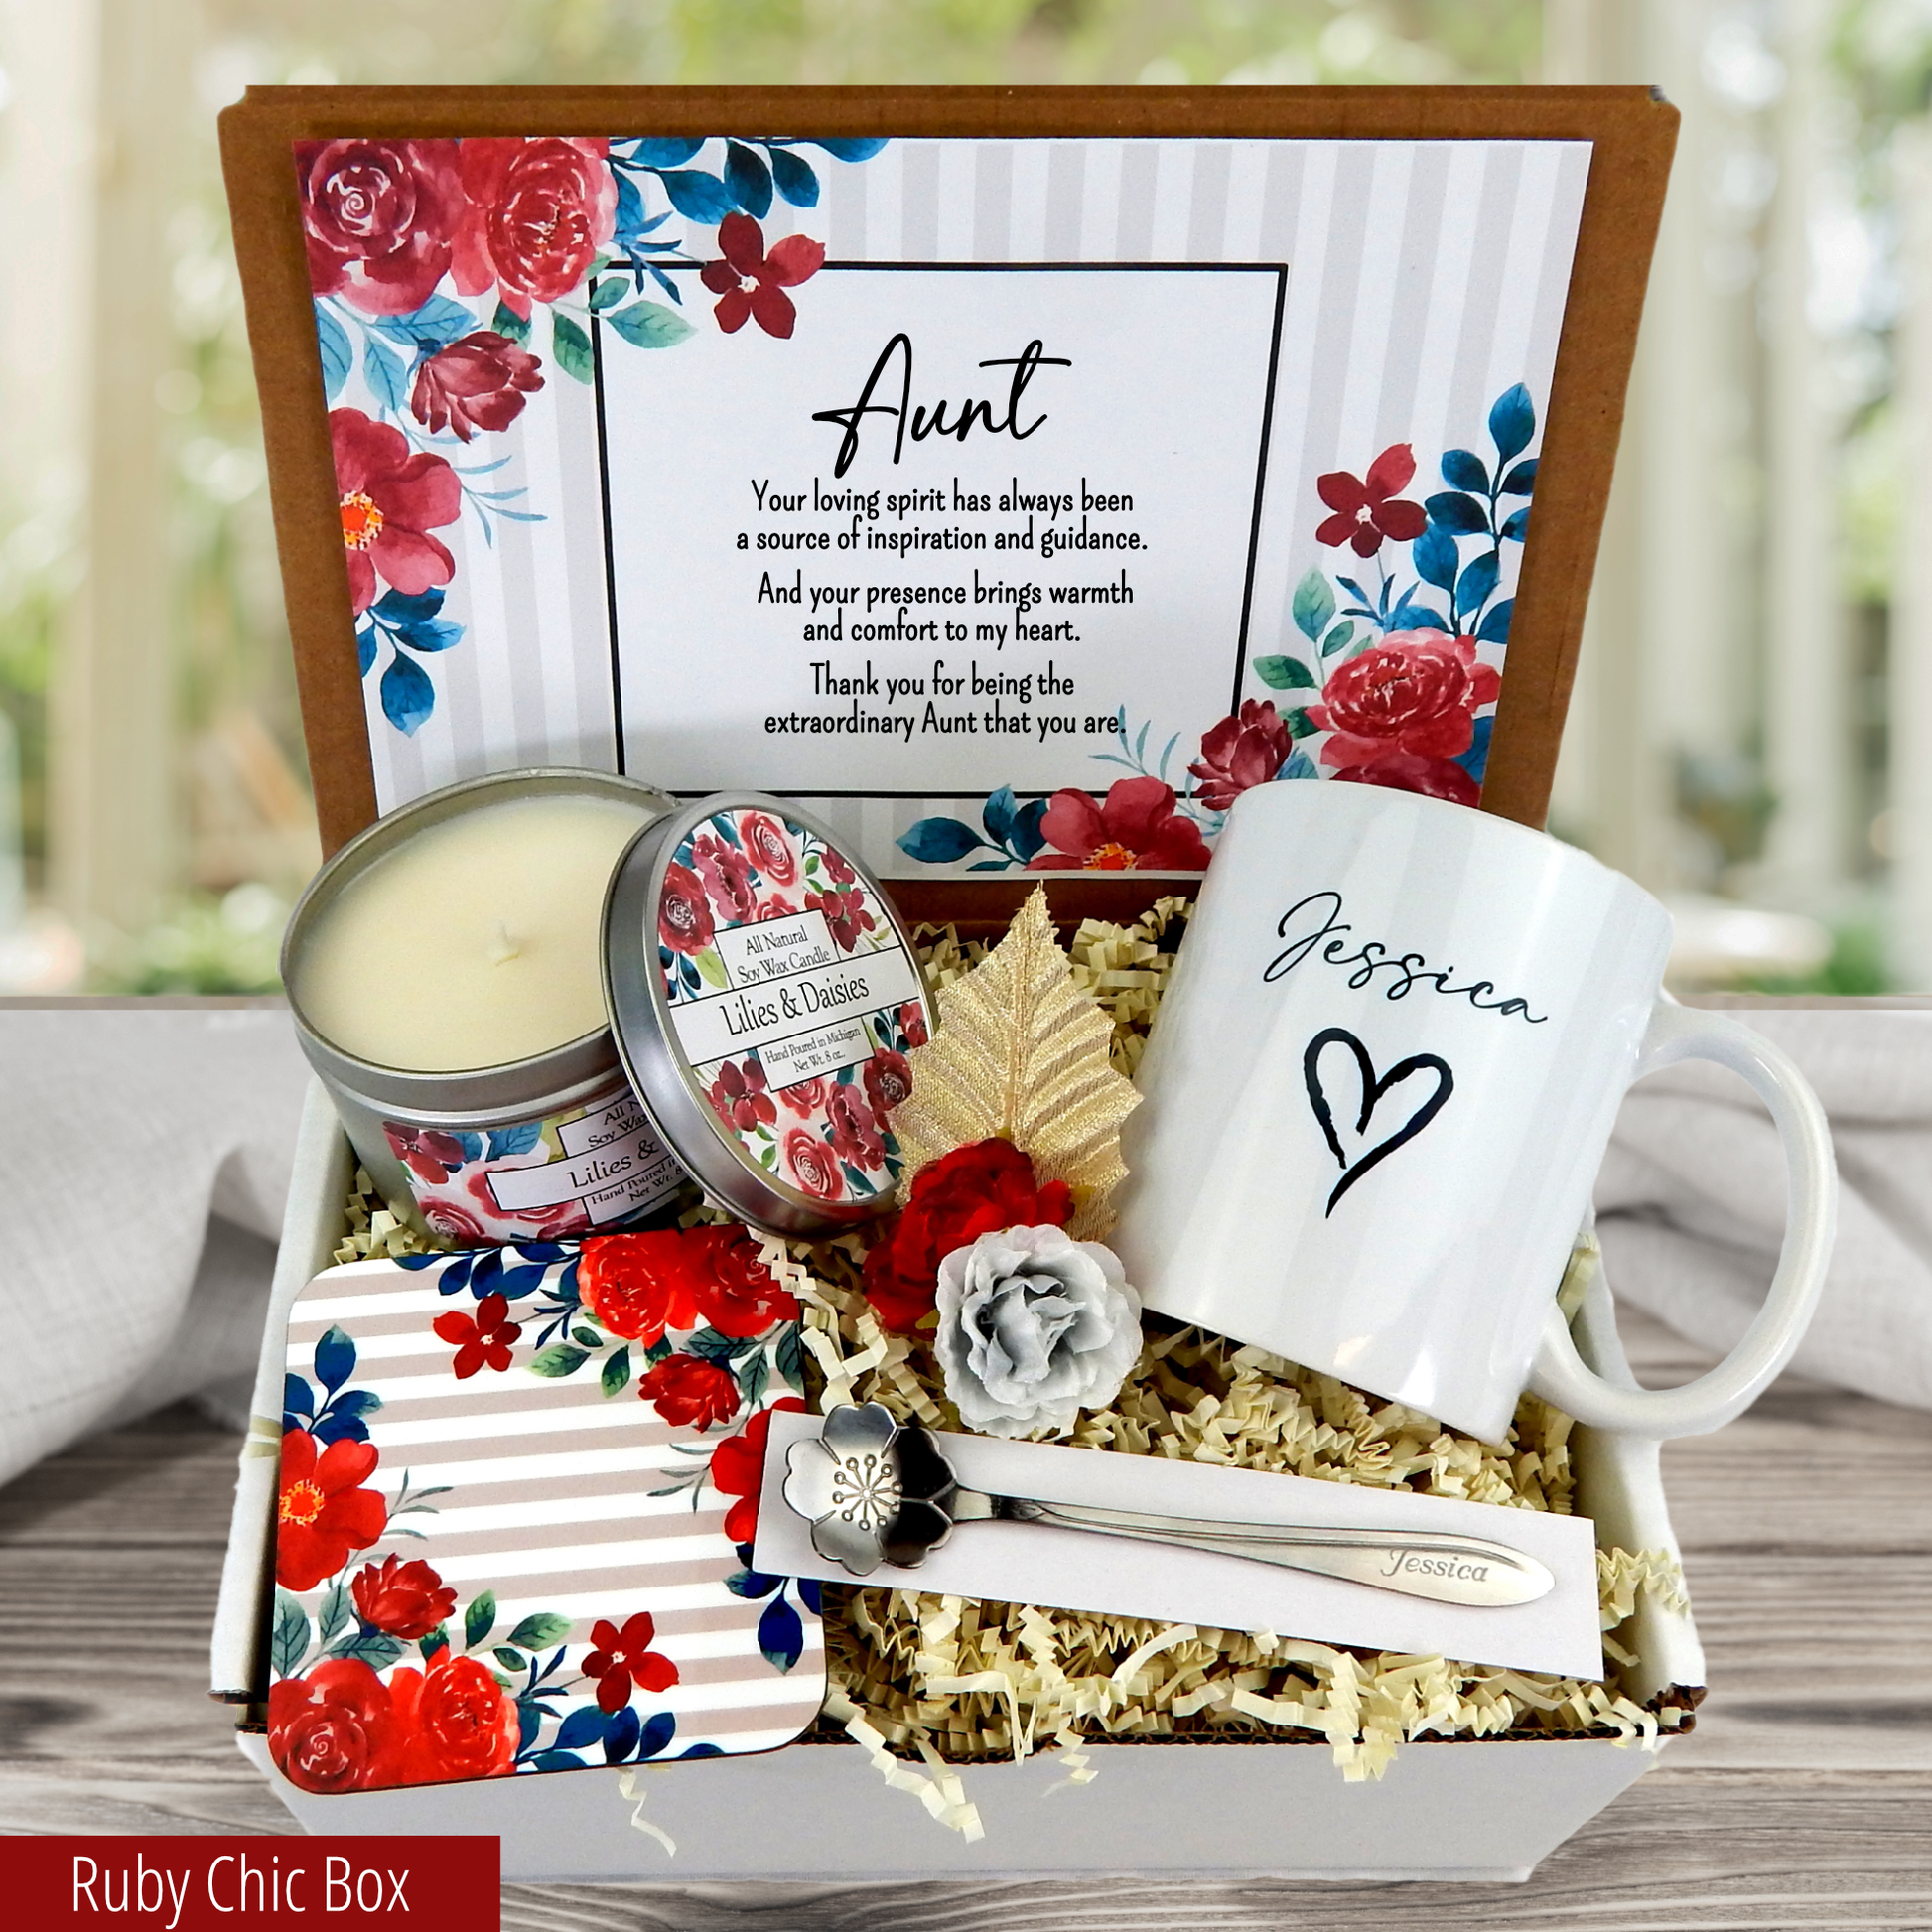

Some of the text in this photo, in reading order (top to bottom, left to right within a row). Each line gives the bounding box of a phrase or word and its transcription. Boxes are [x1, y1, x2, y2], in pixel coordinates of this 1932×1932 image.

[812, 333, 1072, 478] Aunt
[752, 477, 1134, 521] Your loving spirit has always been
[737, 514, 1148, 558] a source of inspiration and guidance.
[758, 569, 1134, 613] And your presence brings warmth
[803, 607, 1081, 650] and comfort to my heart.
[810, 660, 1074, 704] Thank you for being the
[764, 698, 1127, 743] extraordinary Aunt that you are.
[746, 925, 808, 956] All Natural
[1263, 891, 1548, 1023] Jessica
[737, 946, 831, 984] Soy Wax Candle
[719, 974, 870, 1035] Lilies & Daisies
[765, 1028, 861, 1064] Hand Poured in Michigan
[793, 1059, 810, 1073] Net
[825, 1050, 833, 1062] 8
[604, 1105, 625, 1125] All
[588, 1131, 616, 1147] Soy
[567, 1139, 659, 1188] Lilies &
[592, 1185, 624, 1204] Hand
[627, 1162, 666, 1189] Poured
[628, 1187, 650, 1202] Net
[1381, 1548, 1489, 1582] Jessica
